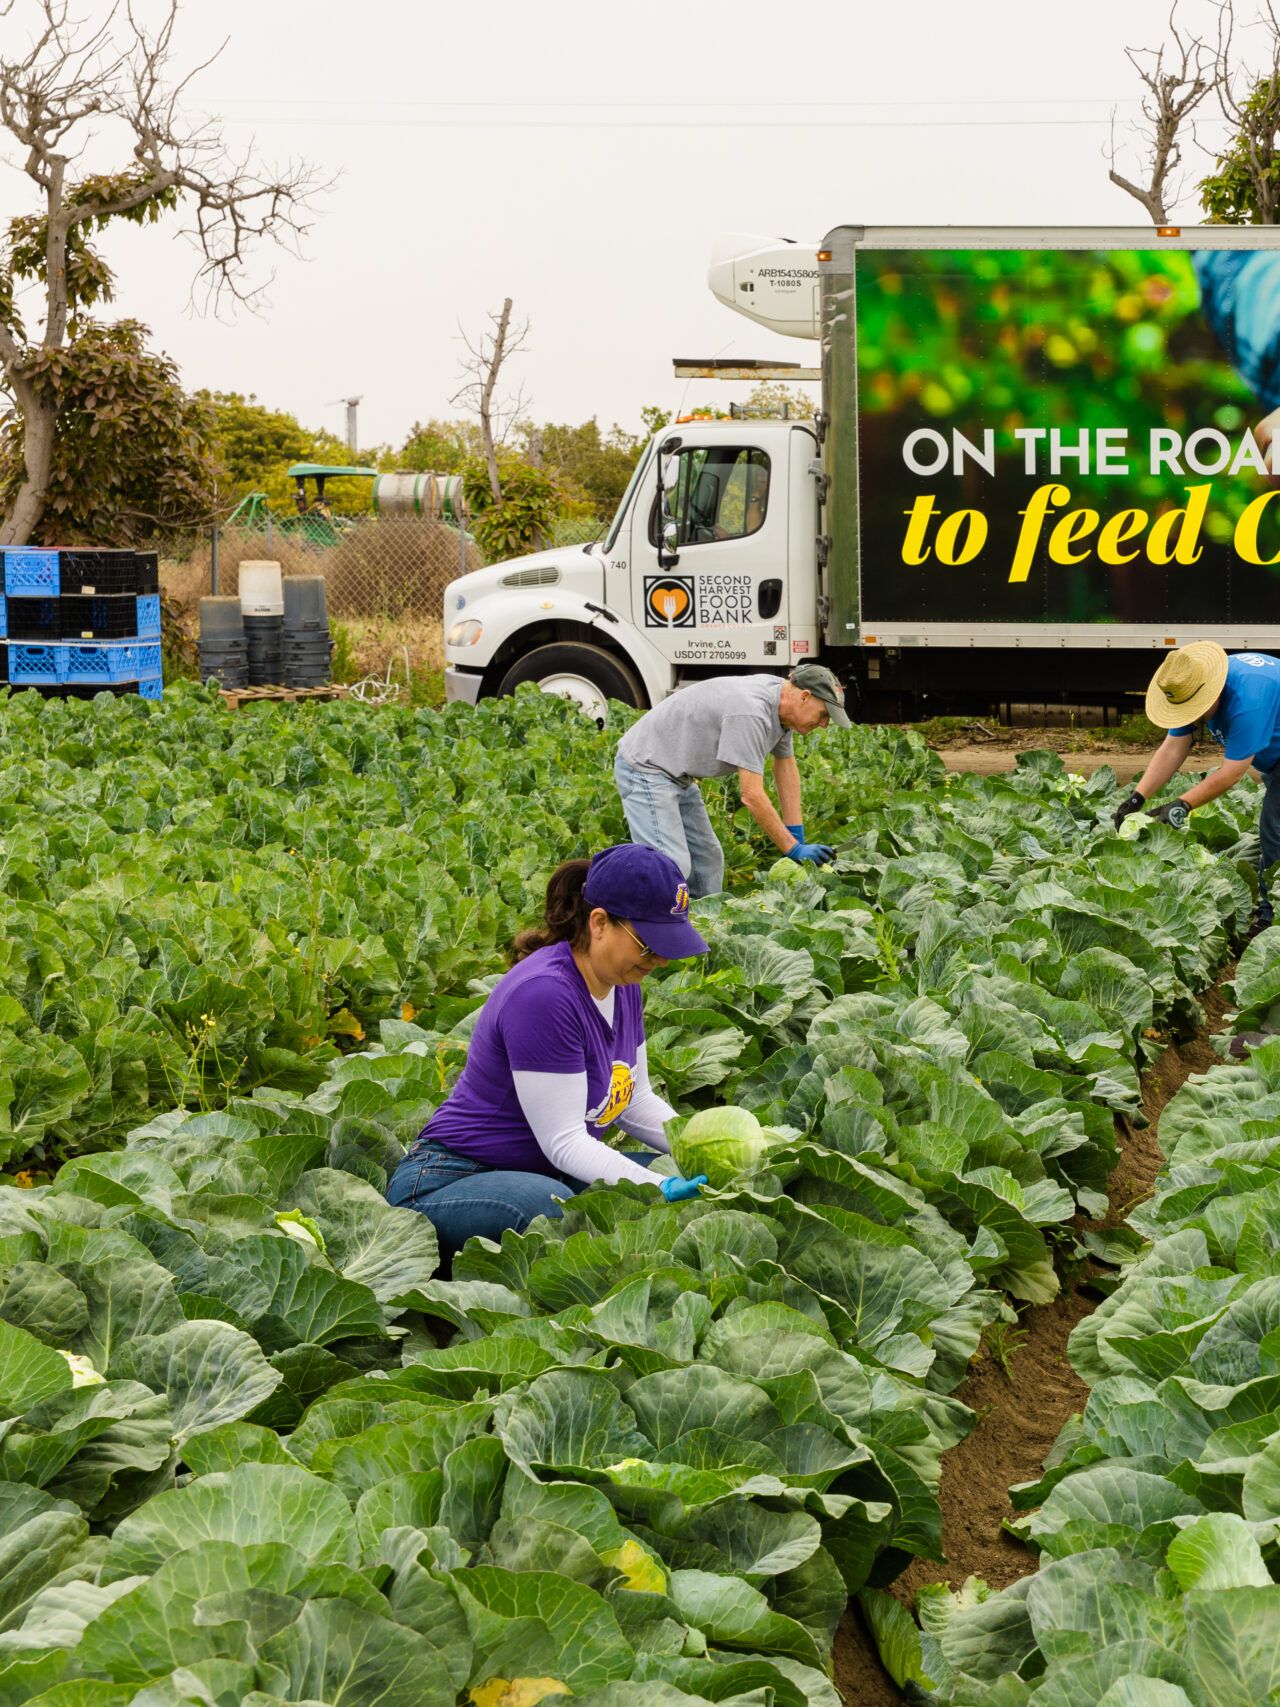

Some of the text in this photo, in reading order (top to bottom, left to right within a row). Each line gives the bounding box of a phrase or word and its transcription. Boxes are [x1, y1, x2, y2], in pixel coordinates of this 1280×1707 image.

[902, 427, 995, 478] ON
[1014, 428, 1129, 475] THE
[901, 494, 989, 566] to
[1008, 483, 1213, 583] feed
[610, 561, 627, 570] 740
[699, 575, 752, 585] SECOND
[699, 585, 752, 595] HARVEST
[699, 595, 752, 609] FOOD
[700, 609, 752, 624] BANK
[688, 640, 731, 649] Irvine, CA
[674, 651, 747, 660] USDOT 2705099
